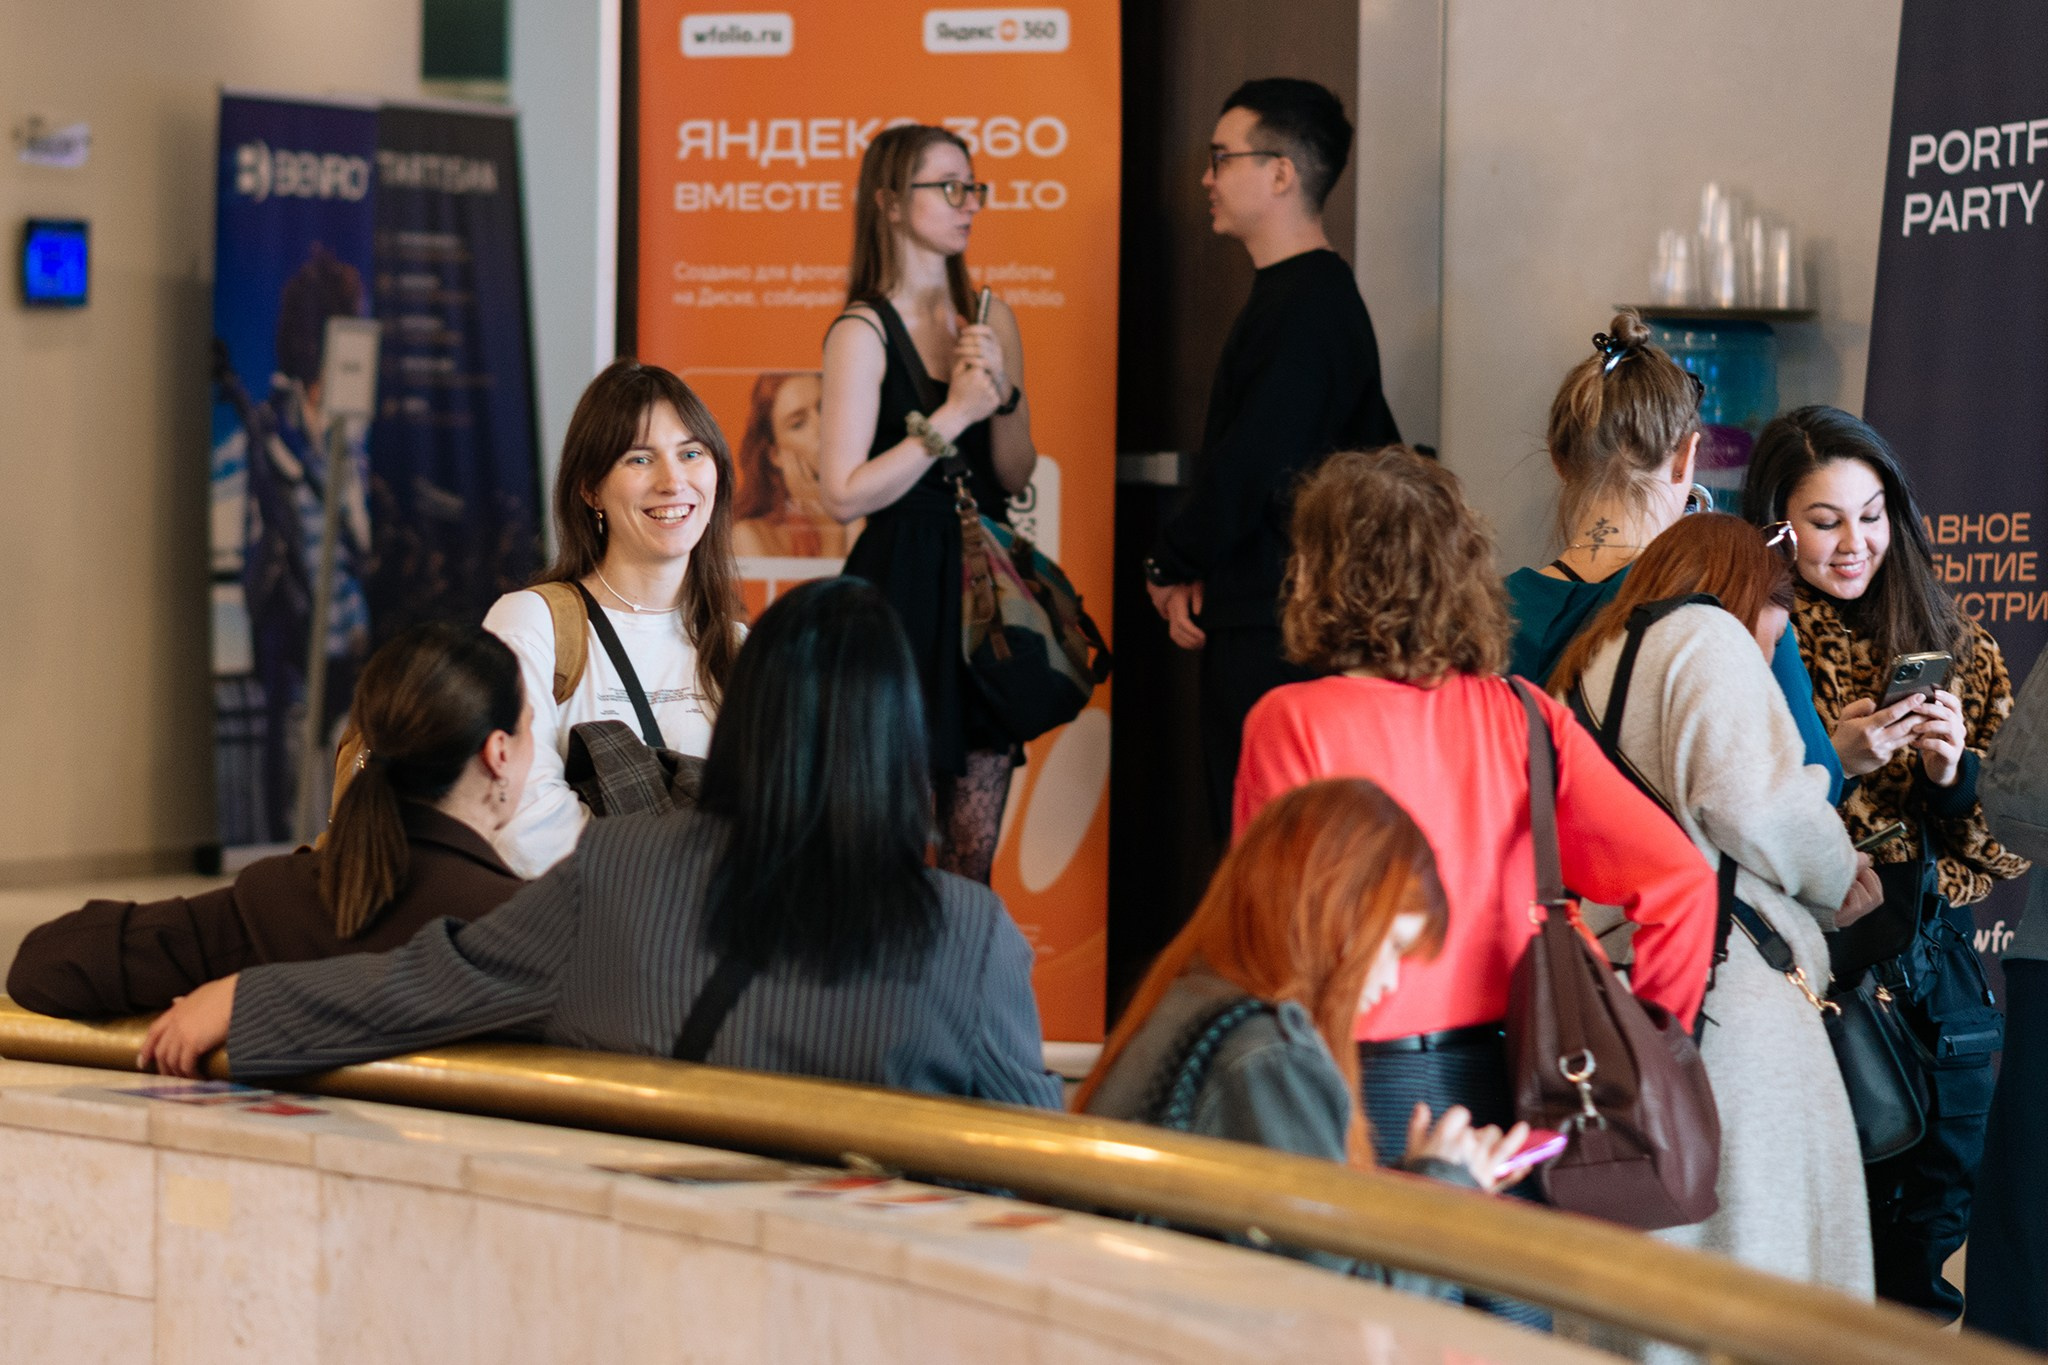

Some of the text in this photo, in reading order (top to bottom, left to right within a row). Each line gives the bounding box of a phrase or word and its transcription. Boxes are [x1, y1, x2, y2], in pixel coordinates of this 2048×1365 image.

[694, 24, 783, 43] wfolio.ru
[936, 19, 1058, 41] Яндекс 360
[676, 116, 921, 169] ЯНДЕК
[674, 181, 843, 212] ВМЕСТЕ
[1902, 179, 2045, 237] PARTY
[1930, 551, 2039, 583] БЫТИЕ
